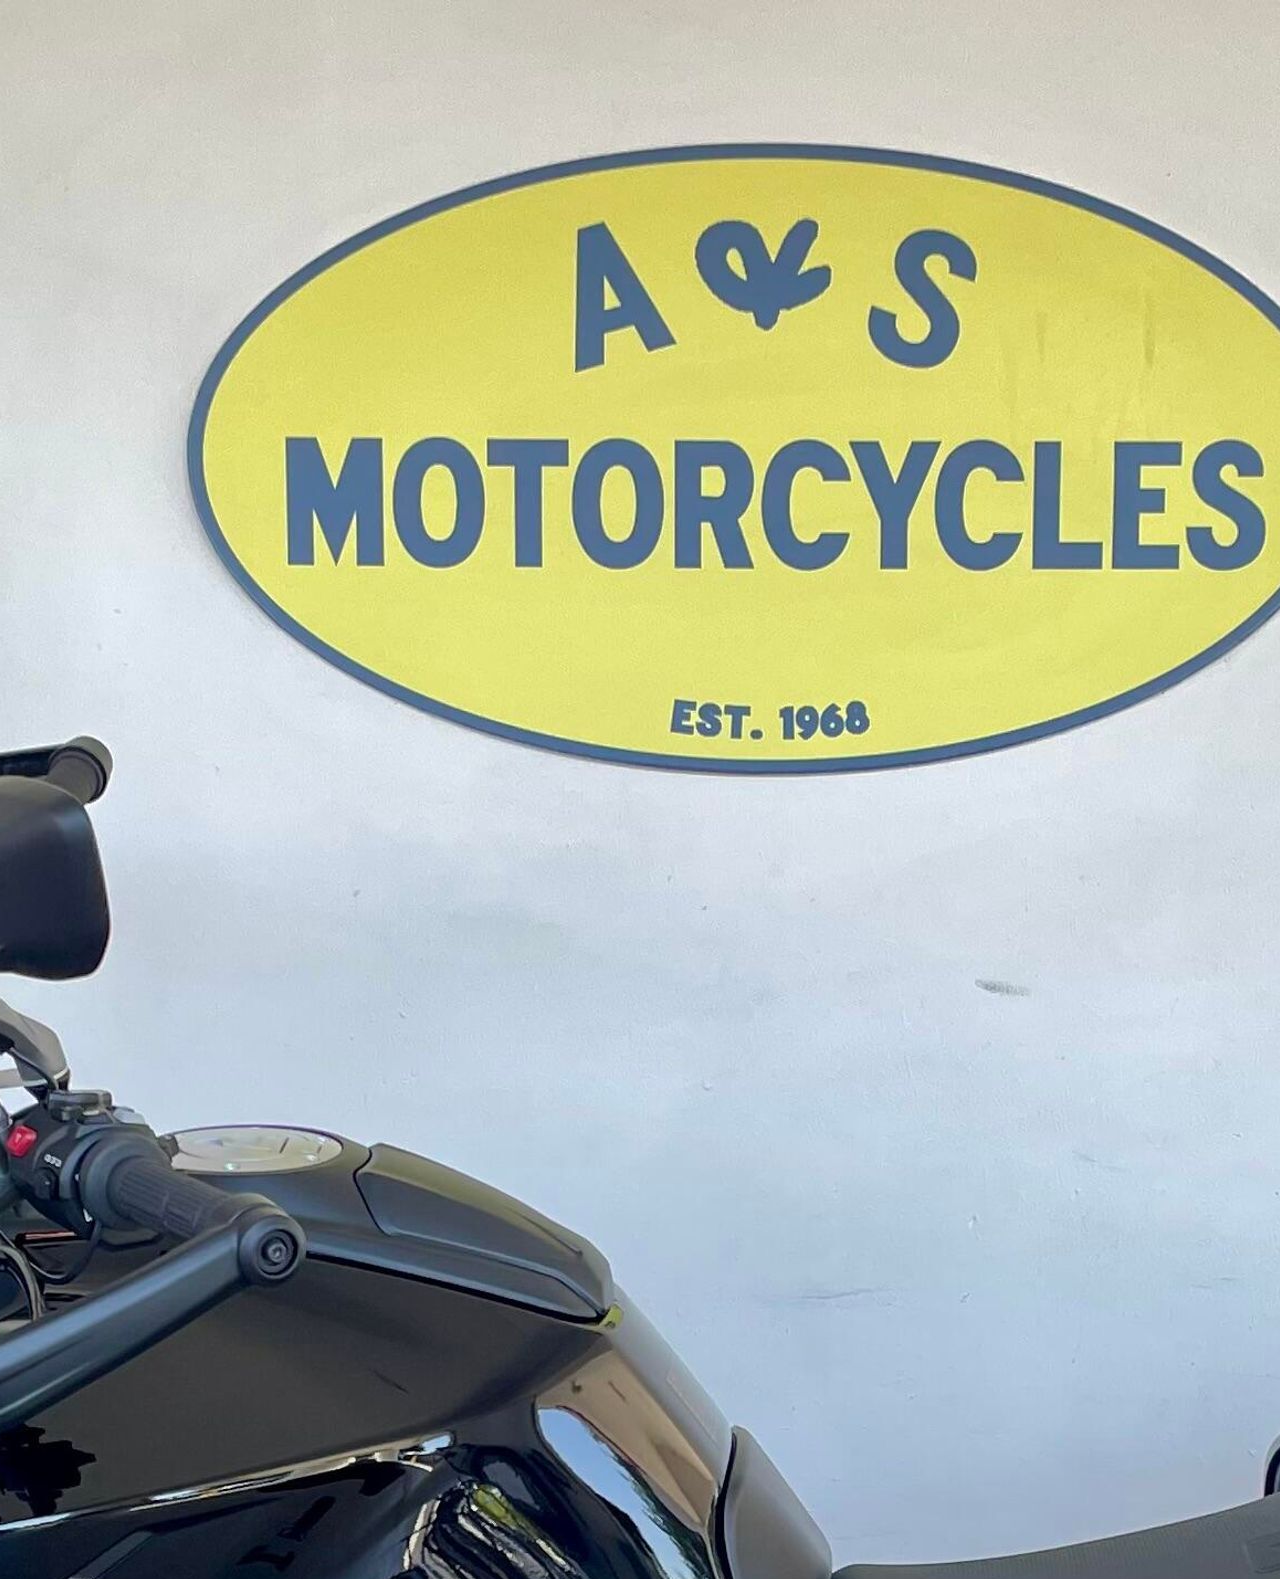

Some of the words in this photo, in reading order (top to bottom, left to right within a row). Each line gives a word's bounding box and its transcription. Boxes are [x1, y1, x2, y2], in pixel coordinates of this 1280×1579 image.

[574, 221, 677, 373] A
[867, 228, 977, 369] S
[285, 436, 1267, 573] MOTORCYCLES
[670, 698, 764, 740] EST.
[778, 700, 871, 740] 1968
